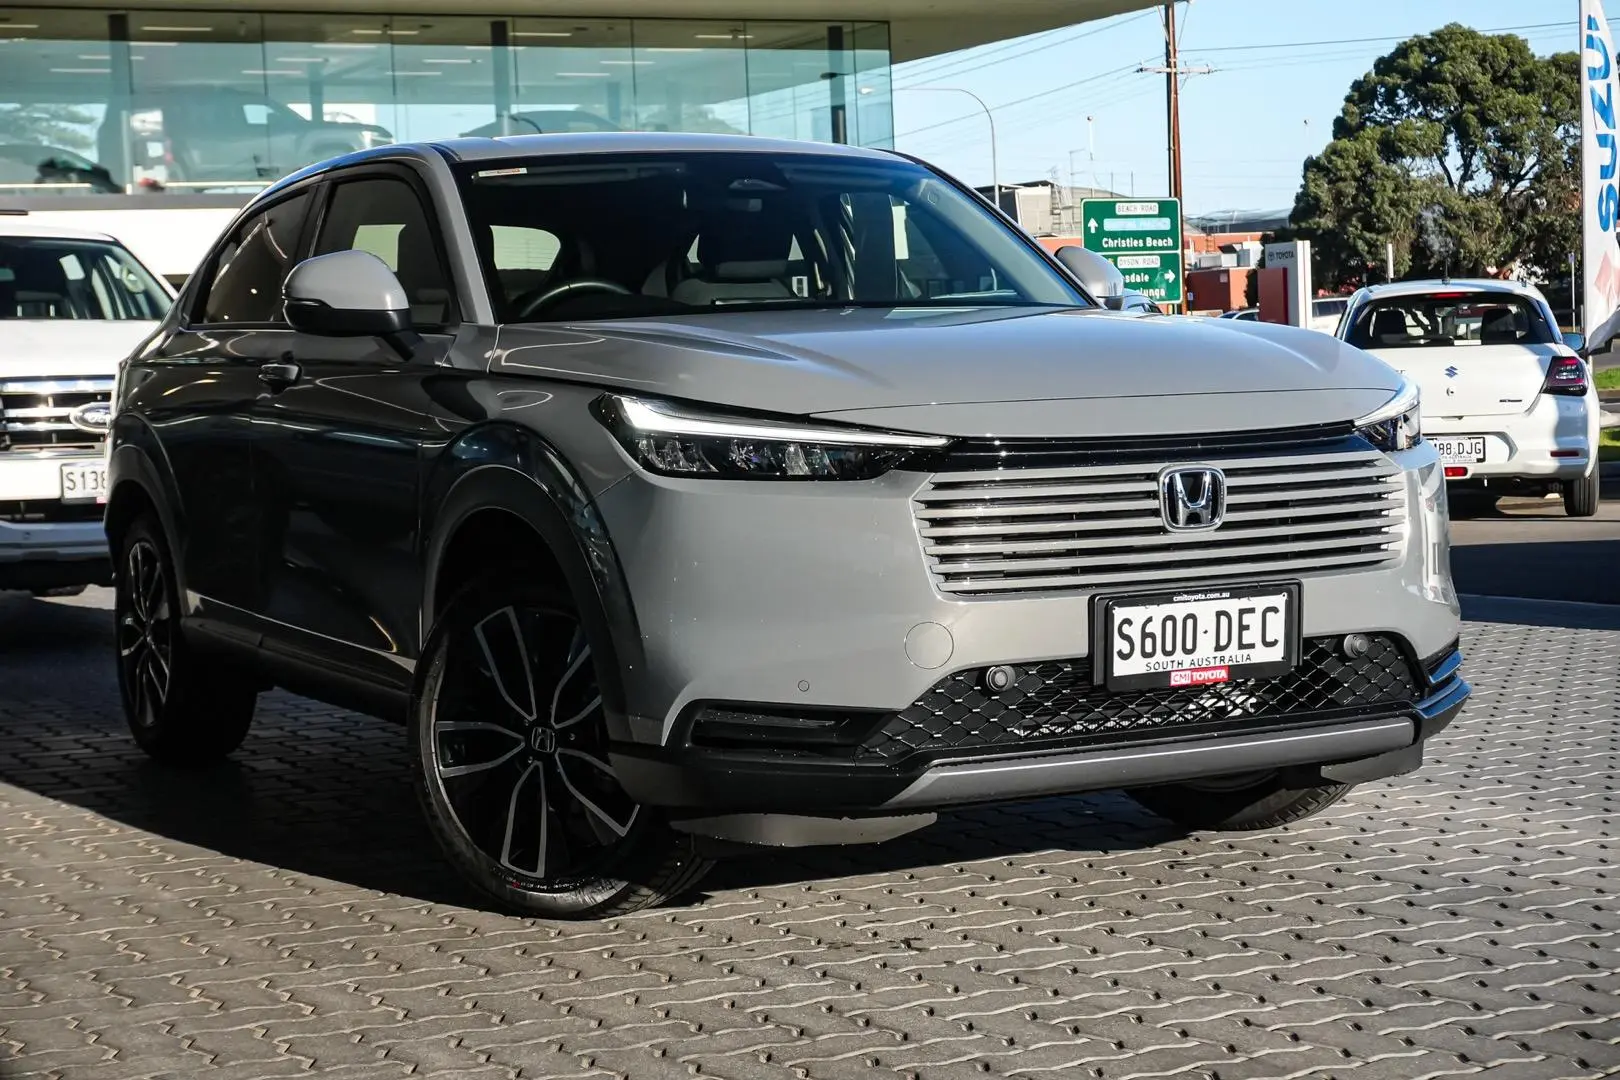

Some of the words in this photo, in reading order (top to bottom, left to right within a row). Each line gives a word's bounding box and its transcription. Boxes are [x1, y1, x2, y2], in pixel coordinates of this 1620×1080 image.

[1117, 204, 1138, 212] BEACH
[1141, 204, 1157, 212] ROAD
[1102, 237, 1144, 248] Christies
[1146, 237, 1173, 247] Beach
[1276, 251, 1294, 260] TOYOTA
[1119, 258, 1139, 266] DYSON
[1142, 257, 1159, 265] ROAD
[1124, 272, 1149, 283] sdale
[1139, 287, 1166, 299] lunga
[1457, 442, 1482, 455] DJG
[1173, 592, 1230, 602] cmitoyota.com.au
[1116, 612, 1198, 661] S600
[1214, 606, 1280, 652] DEC
[1145, 660, 1184, 672] SOUTH
[1189, 653, 1252, 668] AUSTRALIA
[1172, 673, 1191, 684] CMI
[1192, 669, 1227, 681] TOYOTA
